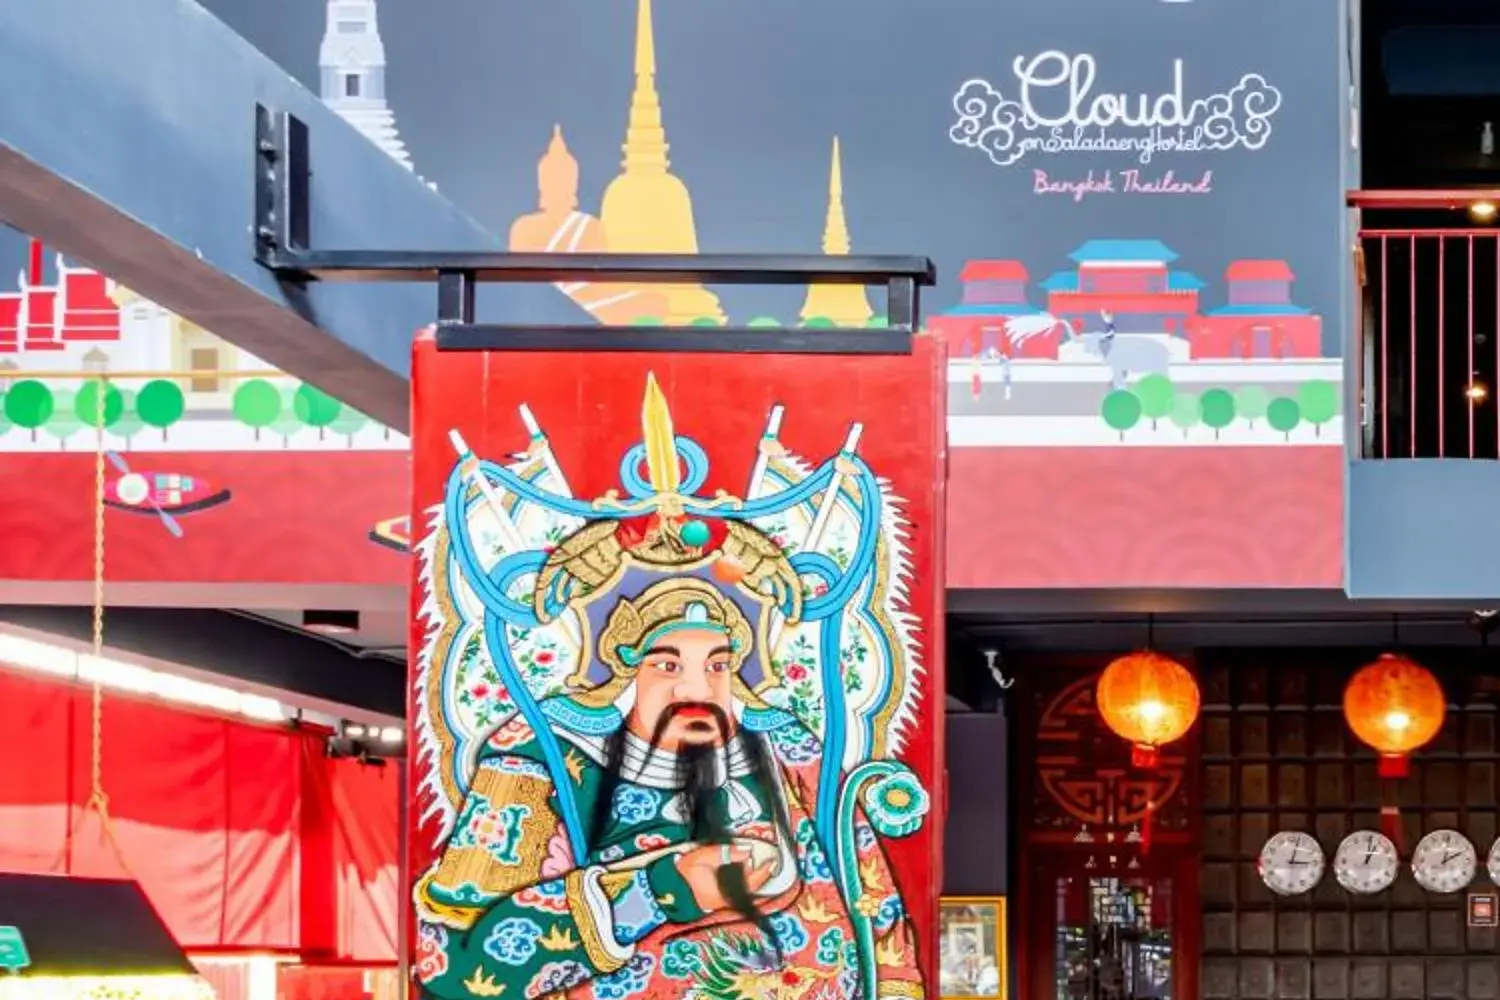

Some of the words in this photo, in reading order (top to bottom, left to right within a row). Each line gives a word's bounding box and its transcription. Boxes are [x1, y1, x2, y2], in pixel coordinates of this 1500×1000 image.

[1013, 50, 1198, 128] Cloud
[1033, 168, 1114, 202] Bangkok
[1119, 168, 1214, 193] Thailand
